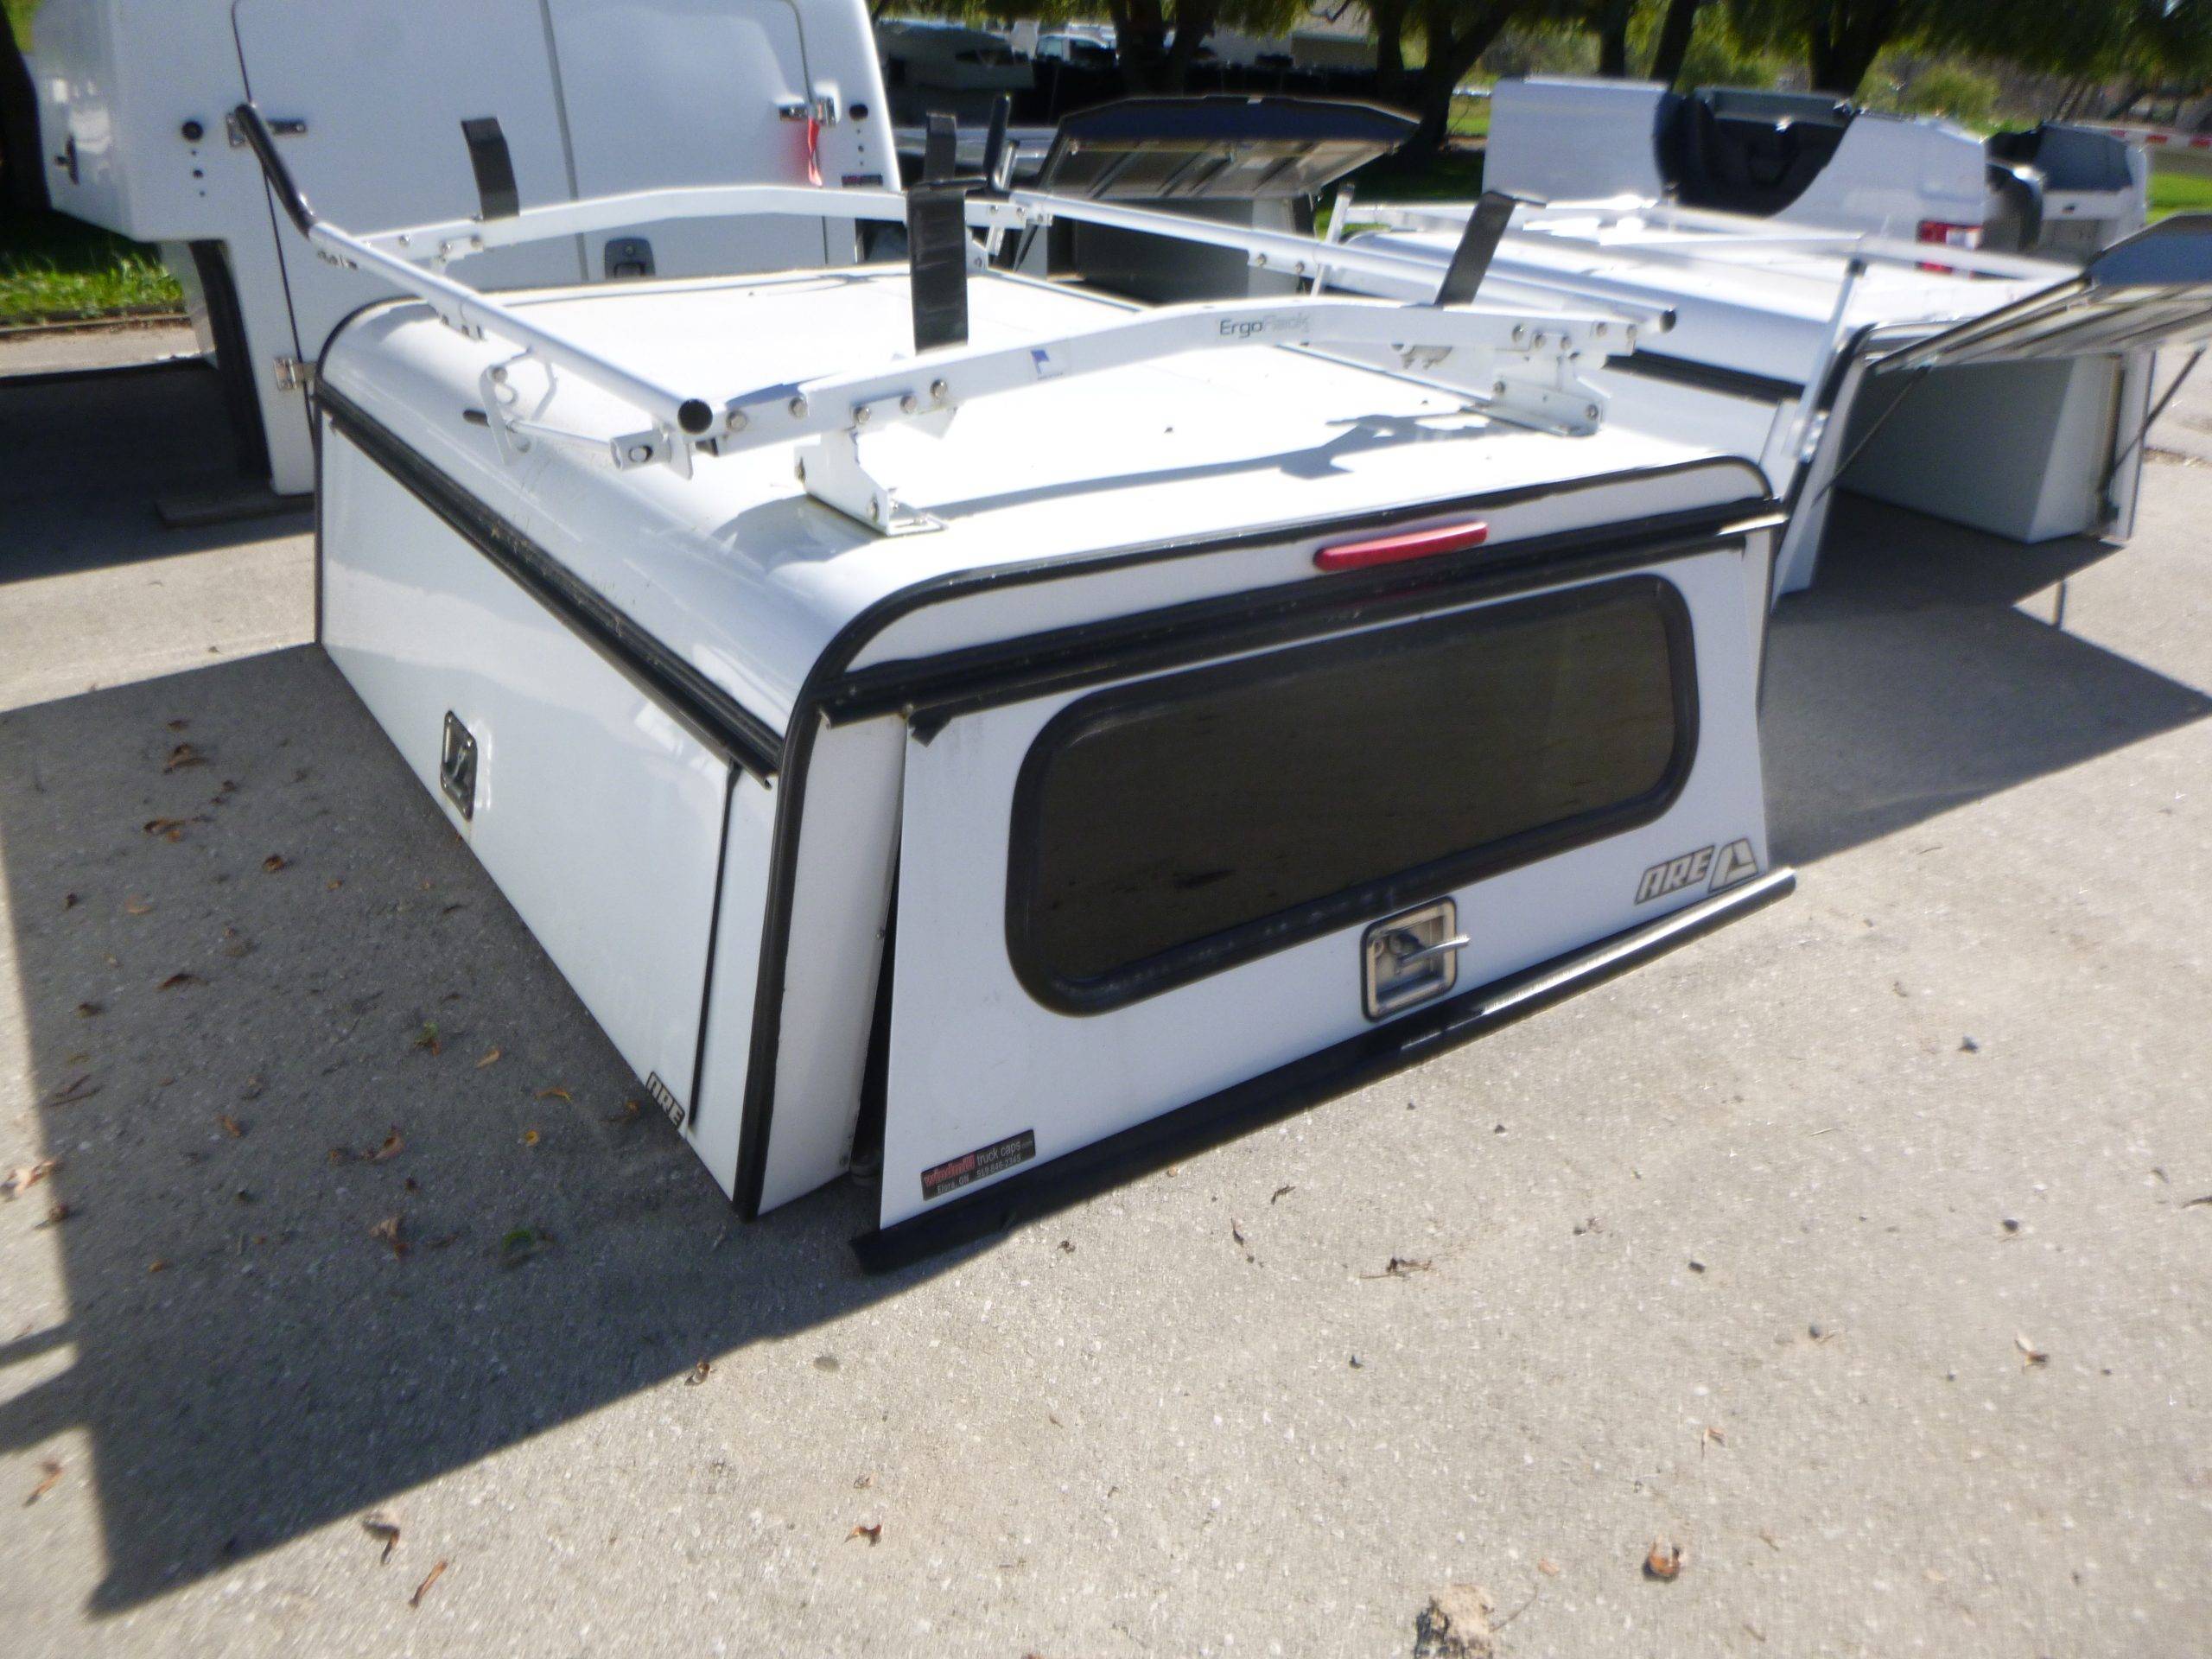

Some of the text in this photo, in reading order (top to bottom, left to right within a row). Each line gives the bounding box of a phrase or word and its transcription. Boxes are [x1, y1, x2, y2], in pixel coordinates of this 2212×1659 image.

[1635, 844, 1715, 906] ARE
[645, 1071, 685, 1128] ARE
[976, 1147, 998, 1166] truck
